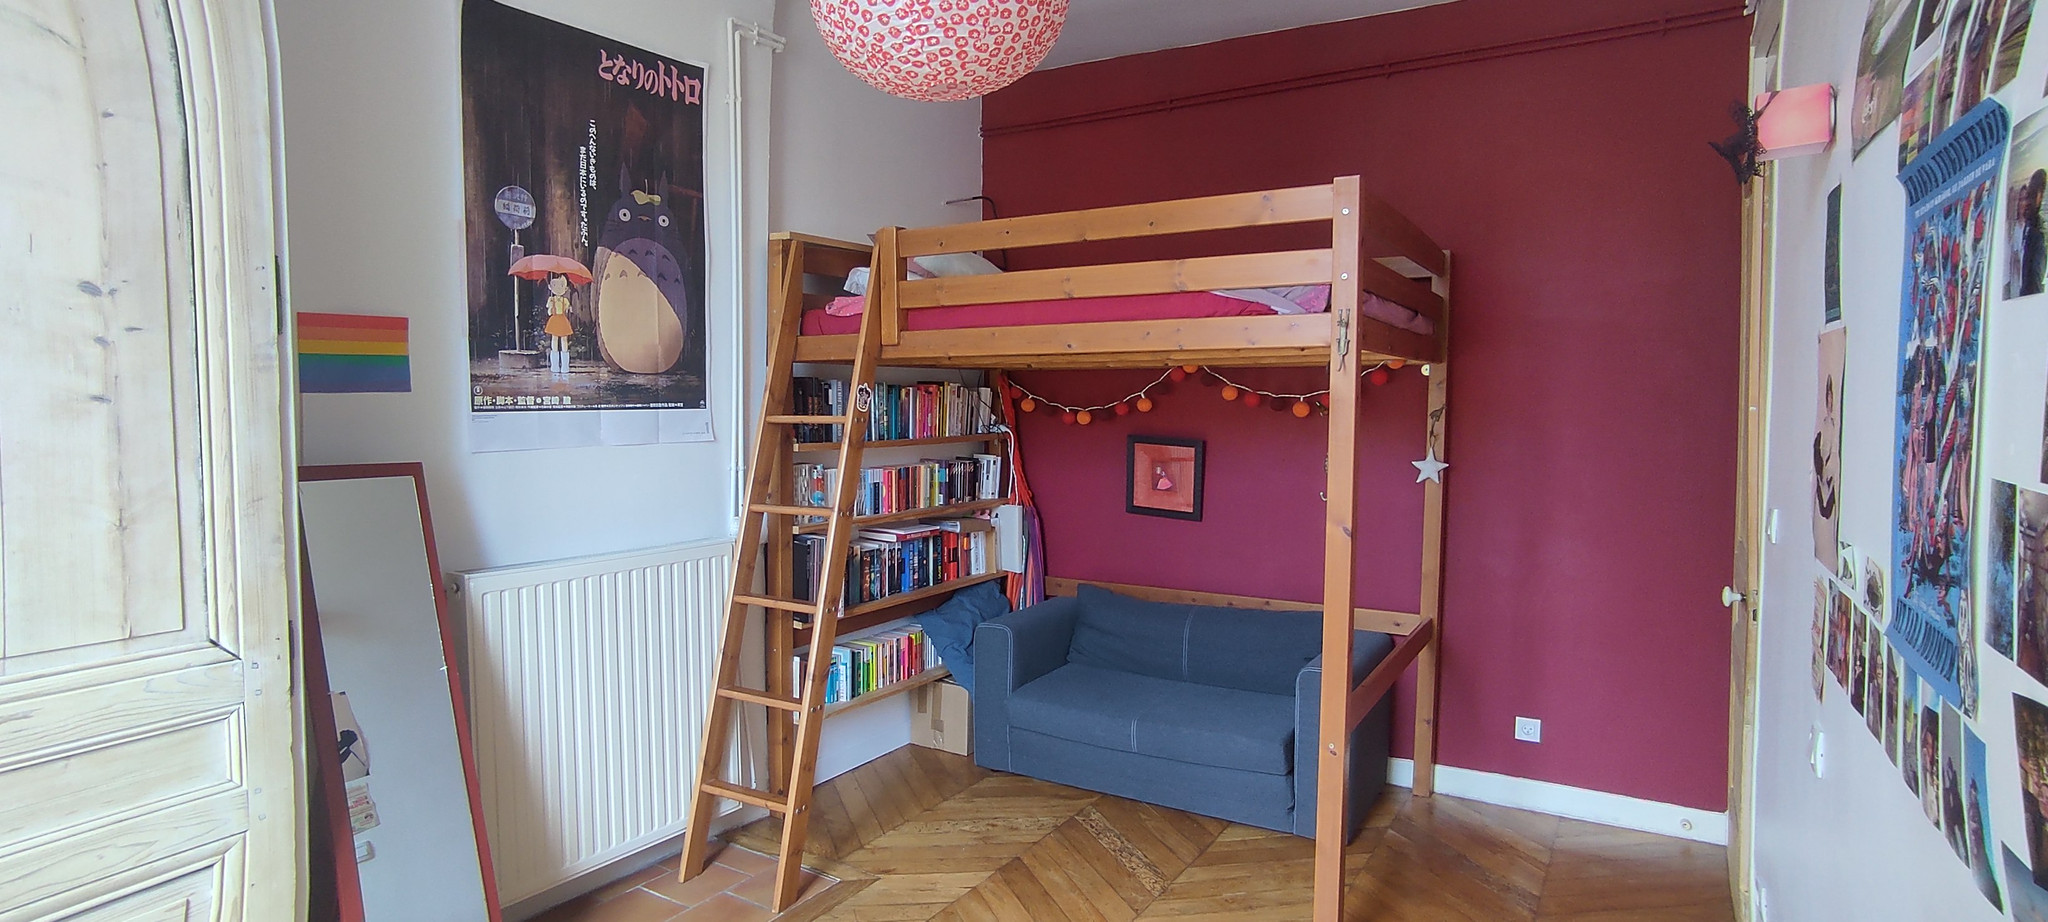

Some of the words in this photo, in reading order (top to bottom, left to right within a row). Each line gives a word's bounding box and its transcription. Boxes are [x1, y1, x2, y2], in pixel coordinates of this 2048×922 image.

[598, 49, 702, 105] となりのトトロ
